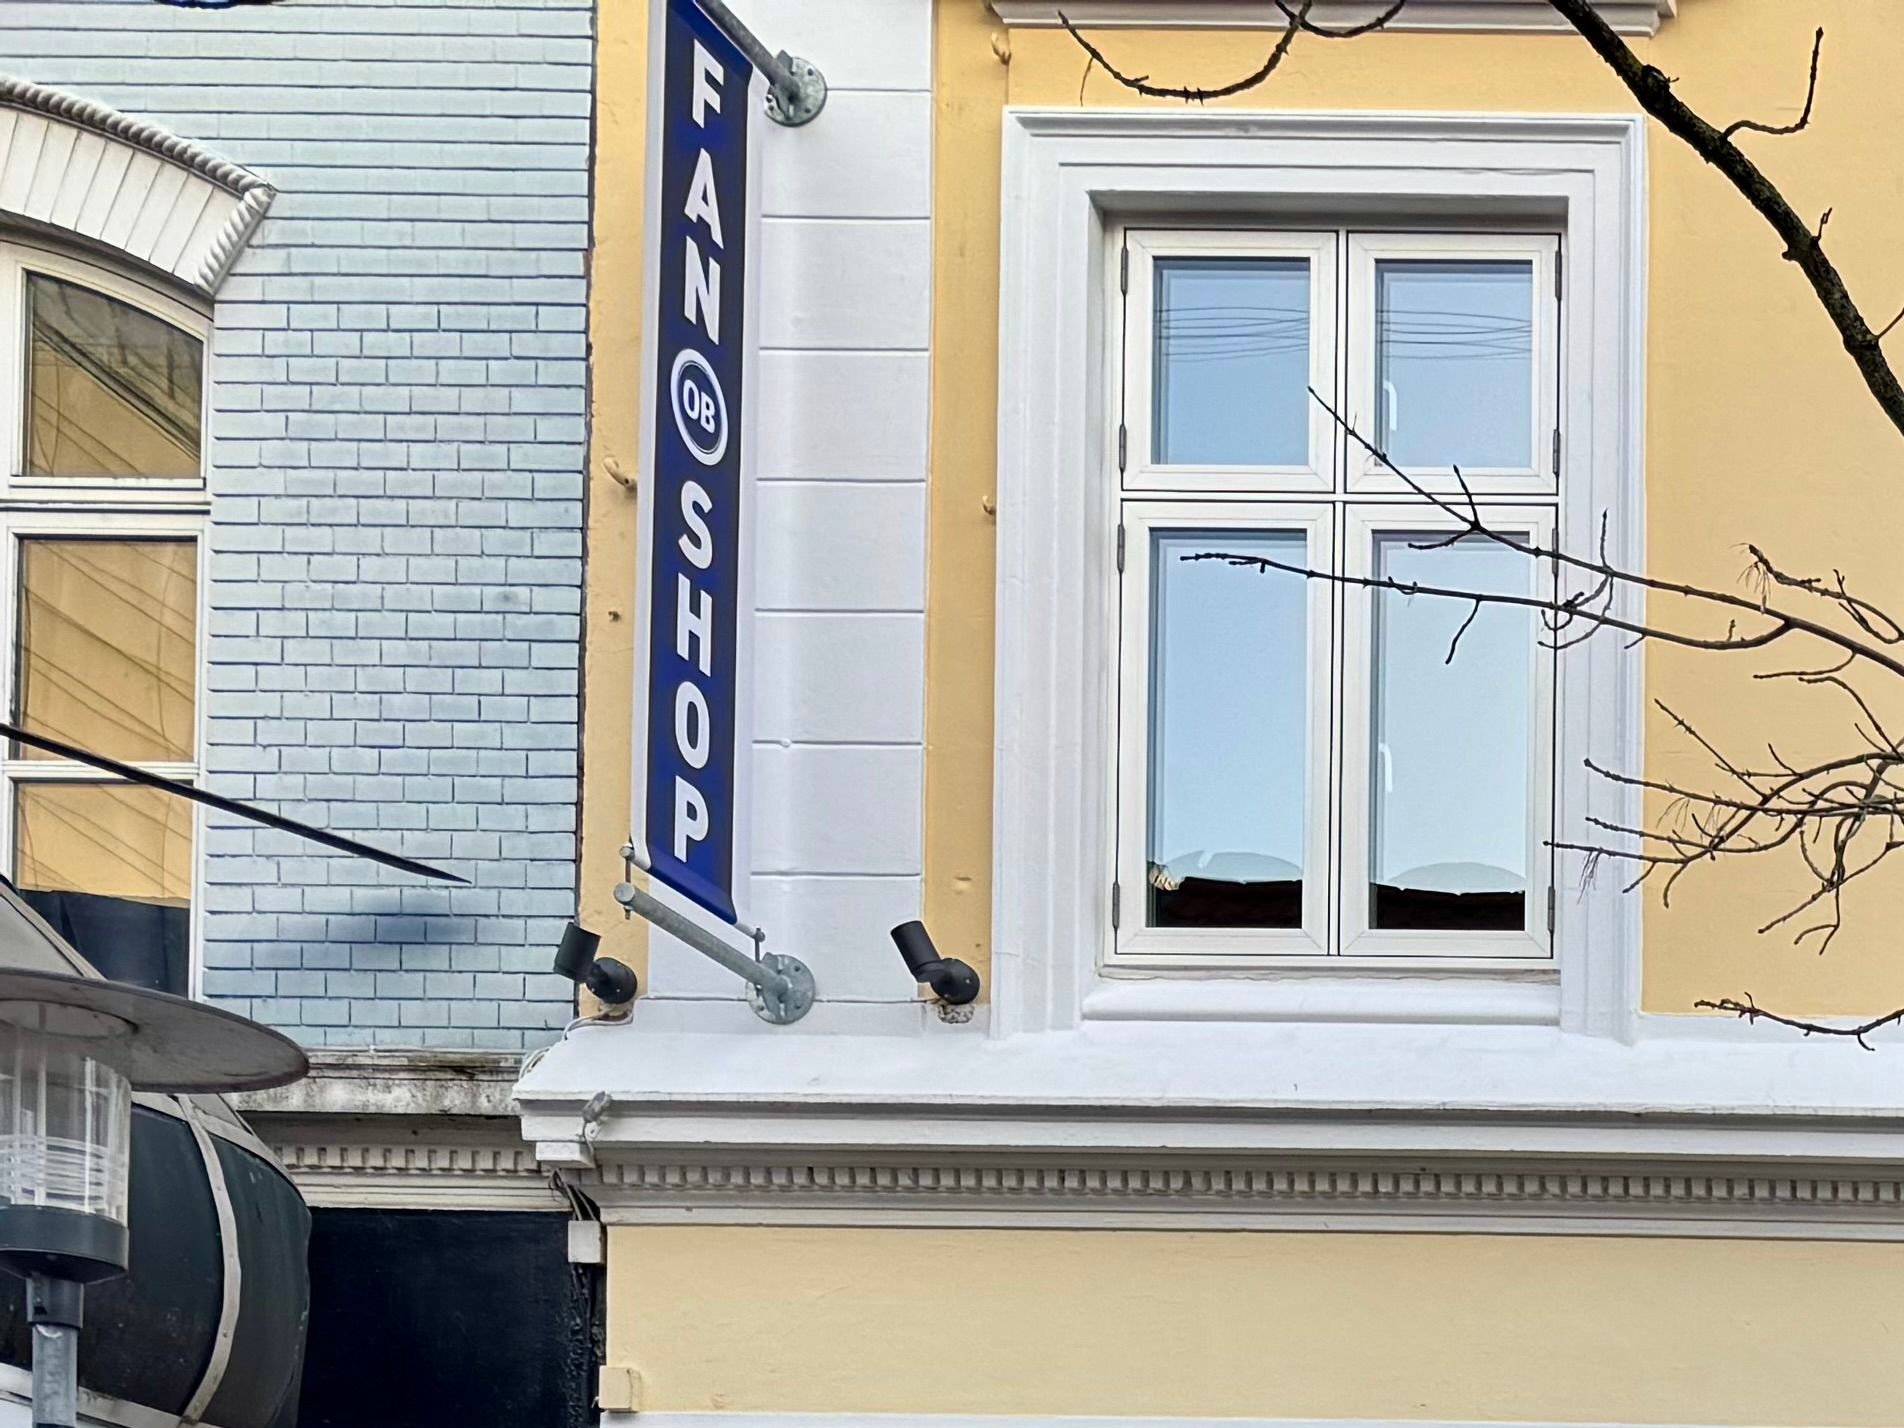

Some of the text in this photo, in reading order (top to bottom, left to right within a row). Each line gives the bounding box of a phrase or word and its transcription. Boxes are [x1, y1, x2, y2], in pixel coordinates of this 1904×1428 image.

[684, 38, 725, 346] FAN
[682, 384, 717, 435] OB
[675, 480, 714, 864] SHOP
